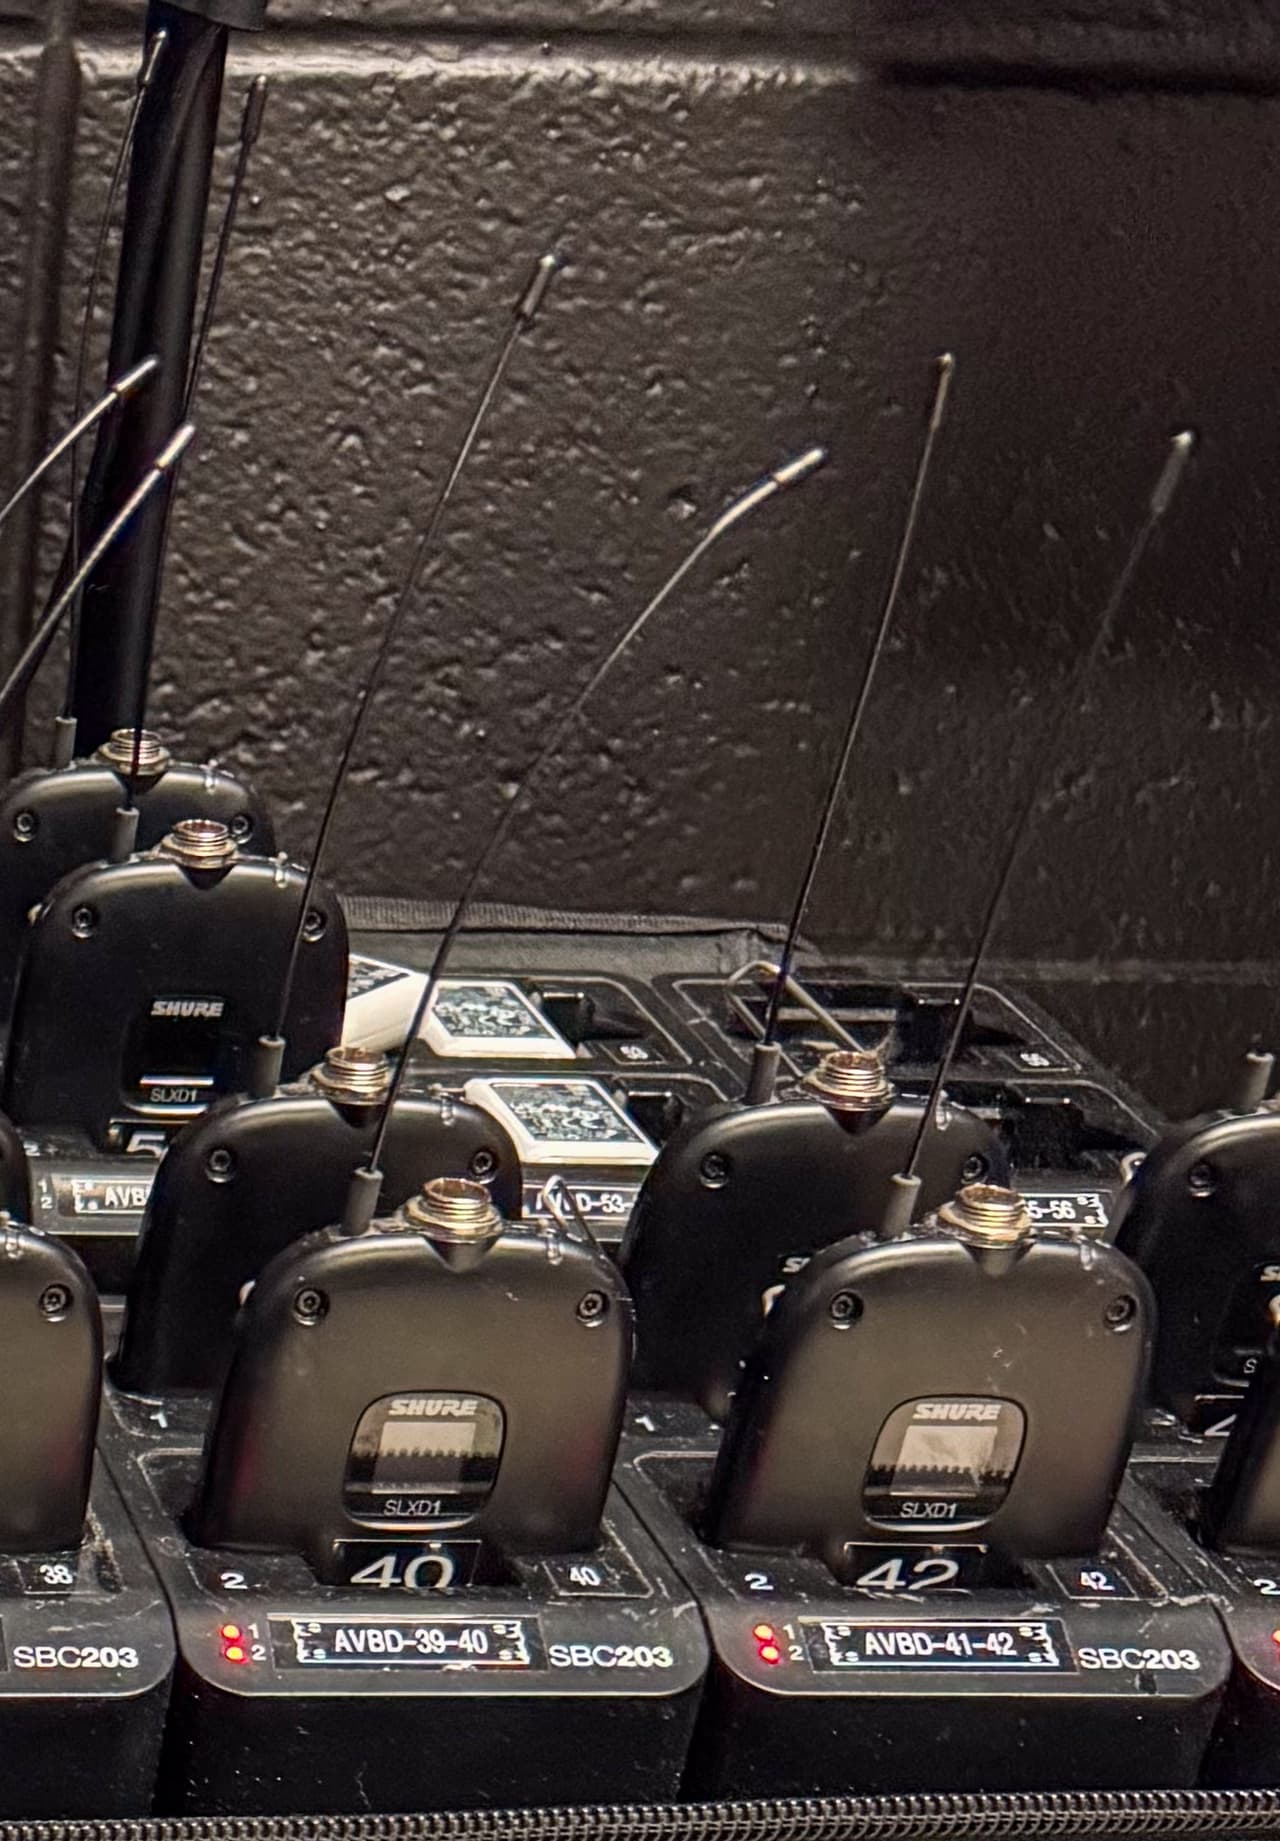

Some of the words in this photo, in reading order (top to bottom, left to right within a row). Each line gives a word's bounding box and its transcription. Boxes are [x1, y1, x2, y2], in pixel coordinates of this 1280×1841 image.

[150, 1000, 225, 1017] SHURE
[150, 1088, 197, 1102] SLXD1
[38, 1179, 48, 1193] 1
[41, 1196, 52, 1209] 2
[388, 1399, 478, 1416] SHURE
[912, 1403, 1002, 1420] SHURE
[383, 1499, 442, 1516] SLXD1
[900, 1501, 957, 1519] SLXD1
[40, 1564, 73, 1585] 38
[350, 1555, 455, 1588] 40
[568, 1566, 602, 1586] 40
[856, 1558, 960, 1590] 42
[220, 1572, 248, 1590] 2
[744, 1573, 773, 1591] 2
[1079, 1571, 1115, 1591] 42
[247, 1624, 260, 1638] 1
[782, 1624, 795, 1639] 1
[333, 1628, 488, 1655] AVBD-39-40
[865, 1631, 1017, 1657] AVBD-41-42
[13, 1646, 139, 1670] SBC203
[250, 1645, 267, 1661] 2
[550, 1645, 673, 1667] SBC203
[788, 1645, 805, 1661] 2
[1079, 1648, 1200, 1671] SBC203
